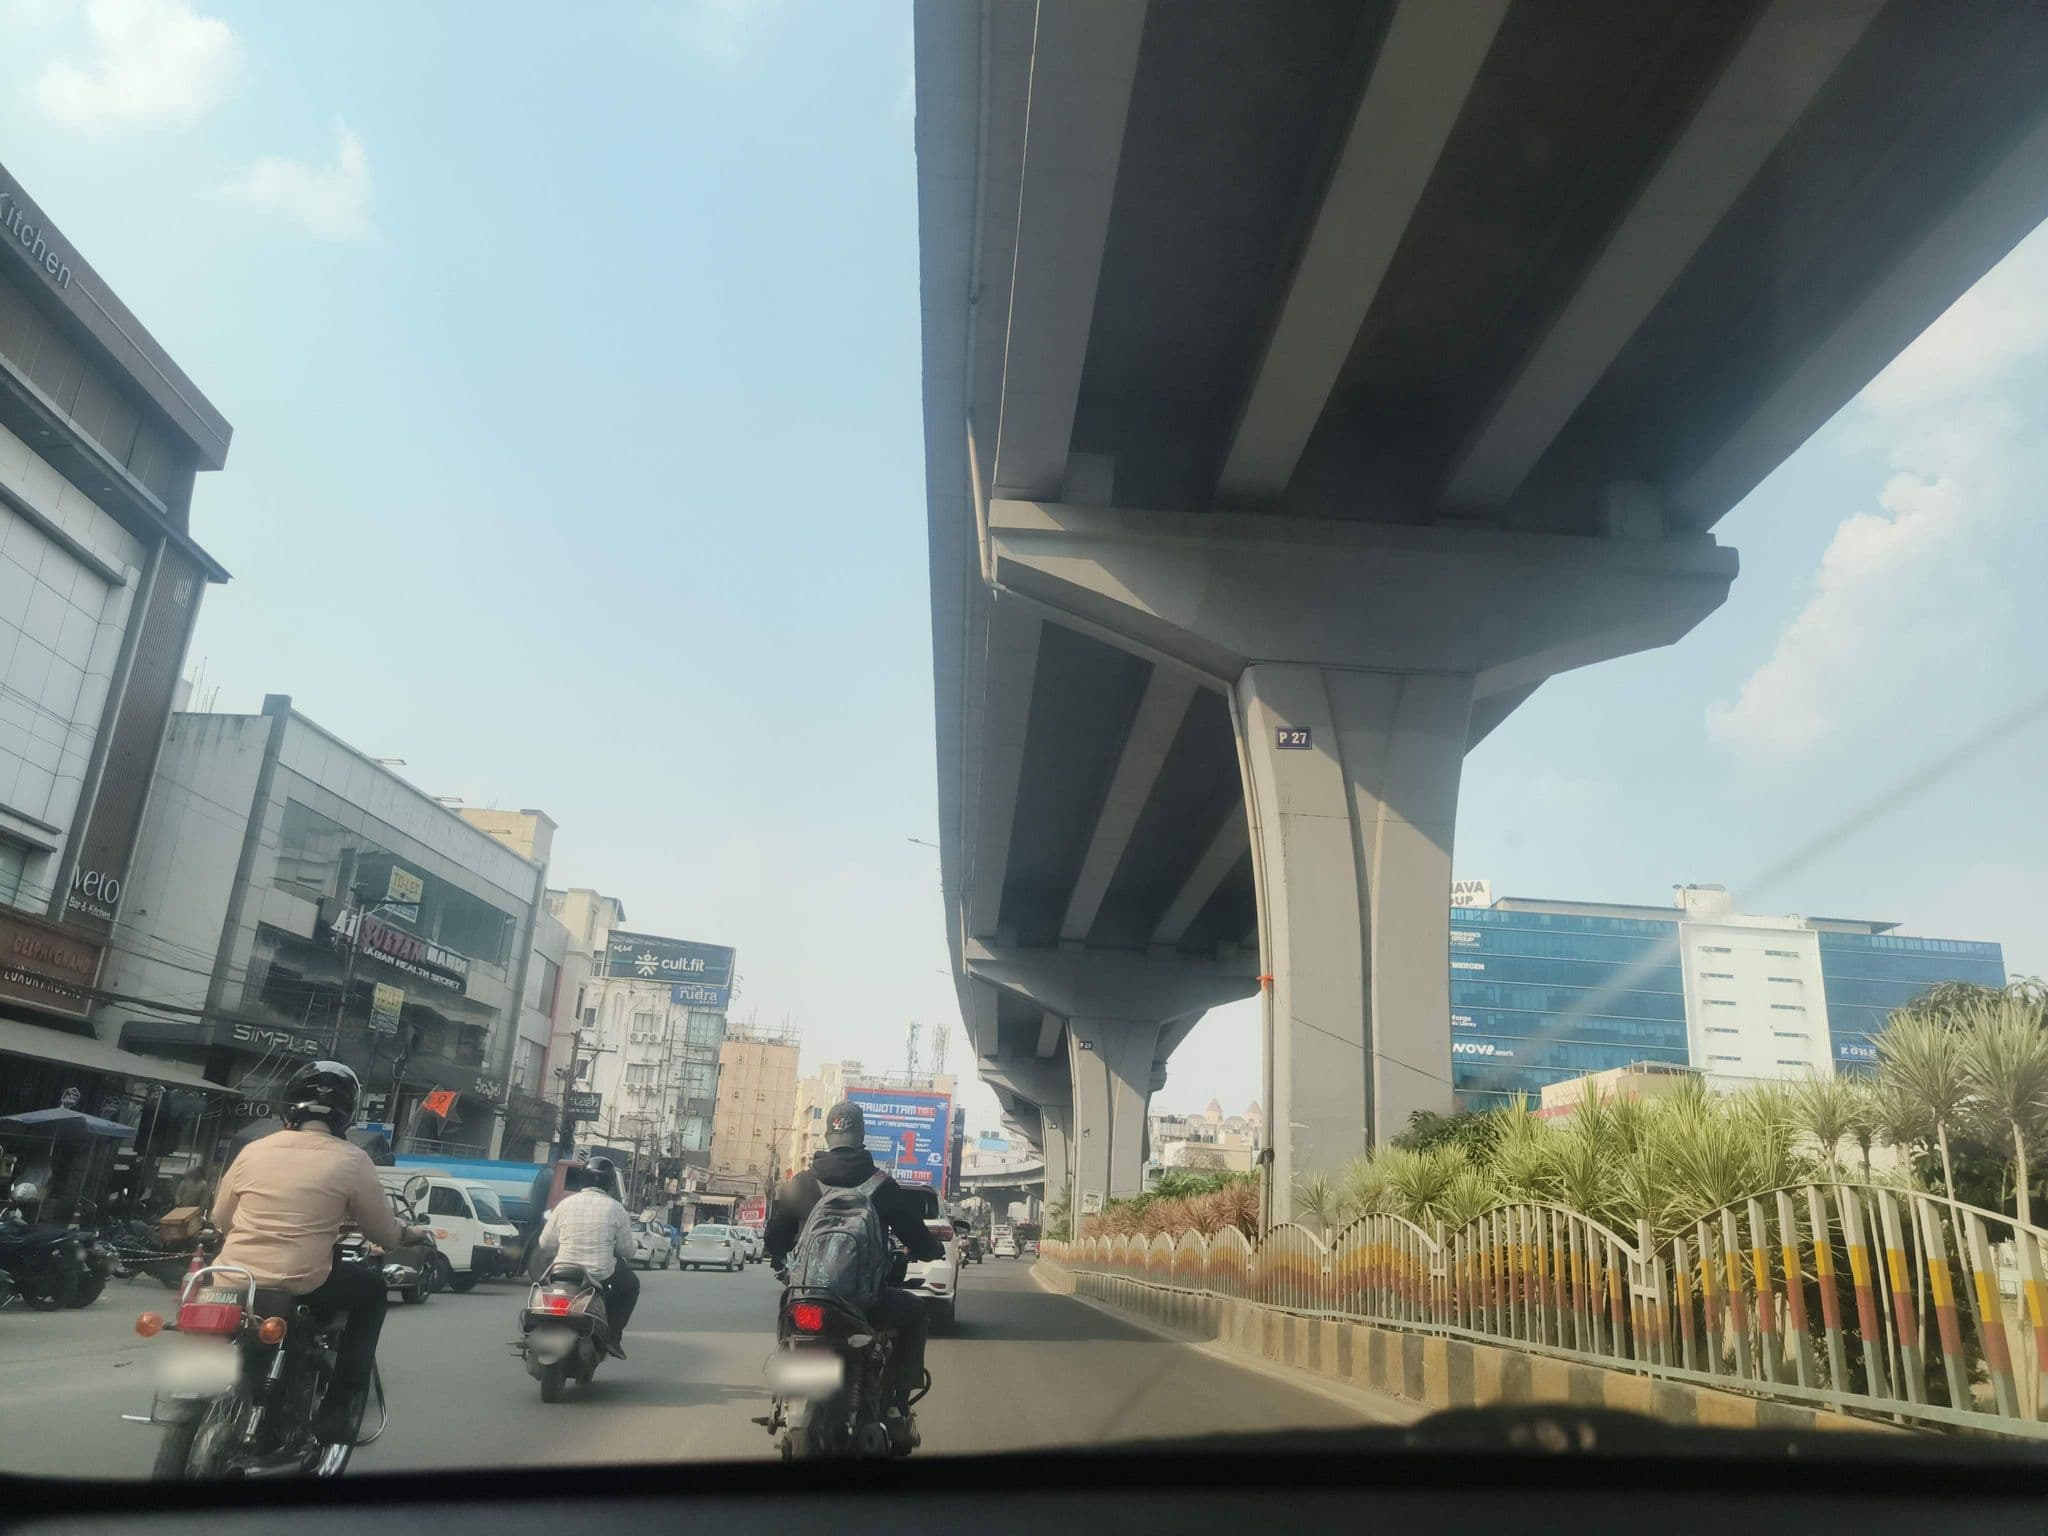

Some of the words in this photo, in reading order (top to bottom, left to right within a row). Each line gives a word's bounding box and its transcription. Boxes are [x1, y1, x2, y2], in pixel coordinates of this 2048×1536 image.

[1279, 731, 1288, 744] P
[1291, 731, 1308, 744] 27
[661, 957, 705, 972] cult.fit
[431, 973, 460, 990] SECRET
[679, 986, 718, 1001] rudra
[854, 1101, 916, 1115] ARWOTTAM
[898, 1130, 919, 1164] 1
[206, 1291, 238, 1304] YAMAHA
